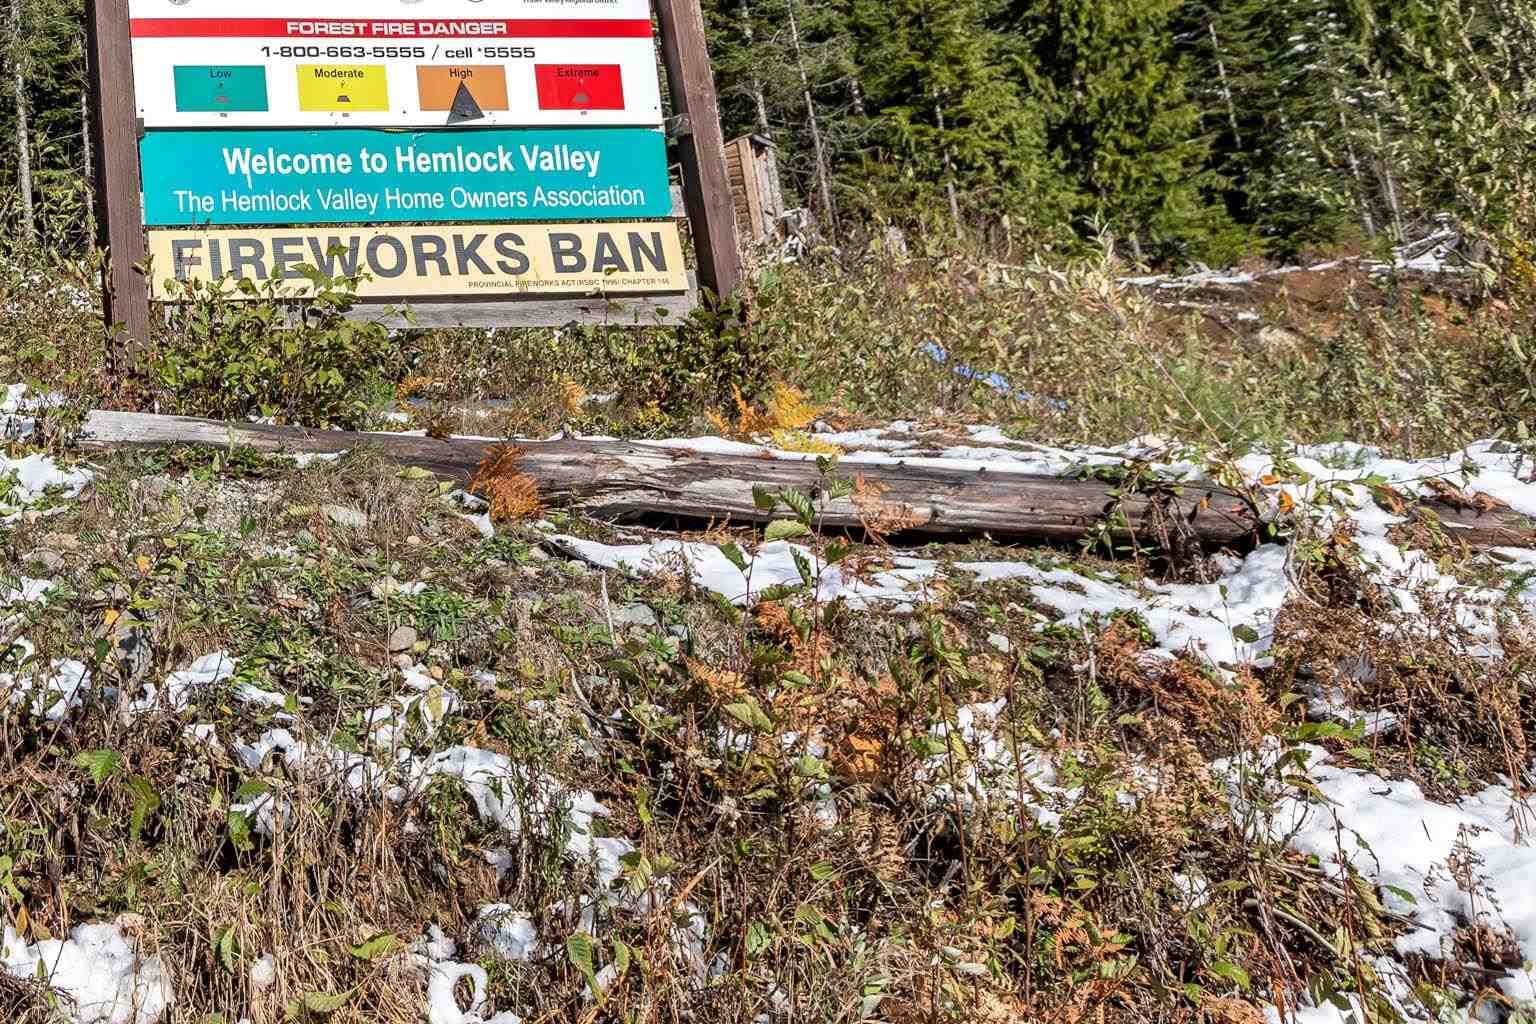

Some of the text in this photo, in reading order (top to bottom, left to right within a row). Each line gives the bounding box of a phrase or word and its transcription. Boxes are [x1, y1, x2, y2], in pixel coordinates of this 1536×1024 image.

[286, 22, 507, 35] FOREST FIRE DANGER
[260, 46, 425, 58] 1-800-663-5555
[445, 46, 473, 58] cell
[210, 69, 232, 79] Low
[314, 68, 364, 78] Moderate
[449, 68, 473, 80] High
[557, 68, 600, 77] Extreme
[222, 144, 600, 177] Welcome to Hemlock Valley
[173, 184, 645, 215] The Hemlock Valley Home Owners Association
[171, 231, 668, 281] FIREWORKS BAN
[468, 279, 514, 289] PROVINCIAL
[515, 279, 560, 288] FIREWORKS
[561, 278, 576, 287] ACT
[622, 278, 656, 286] CHAPTER
